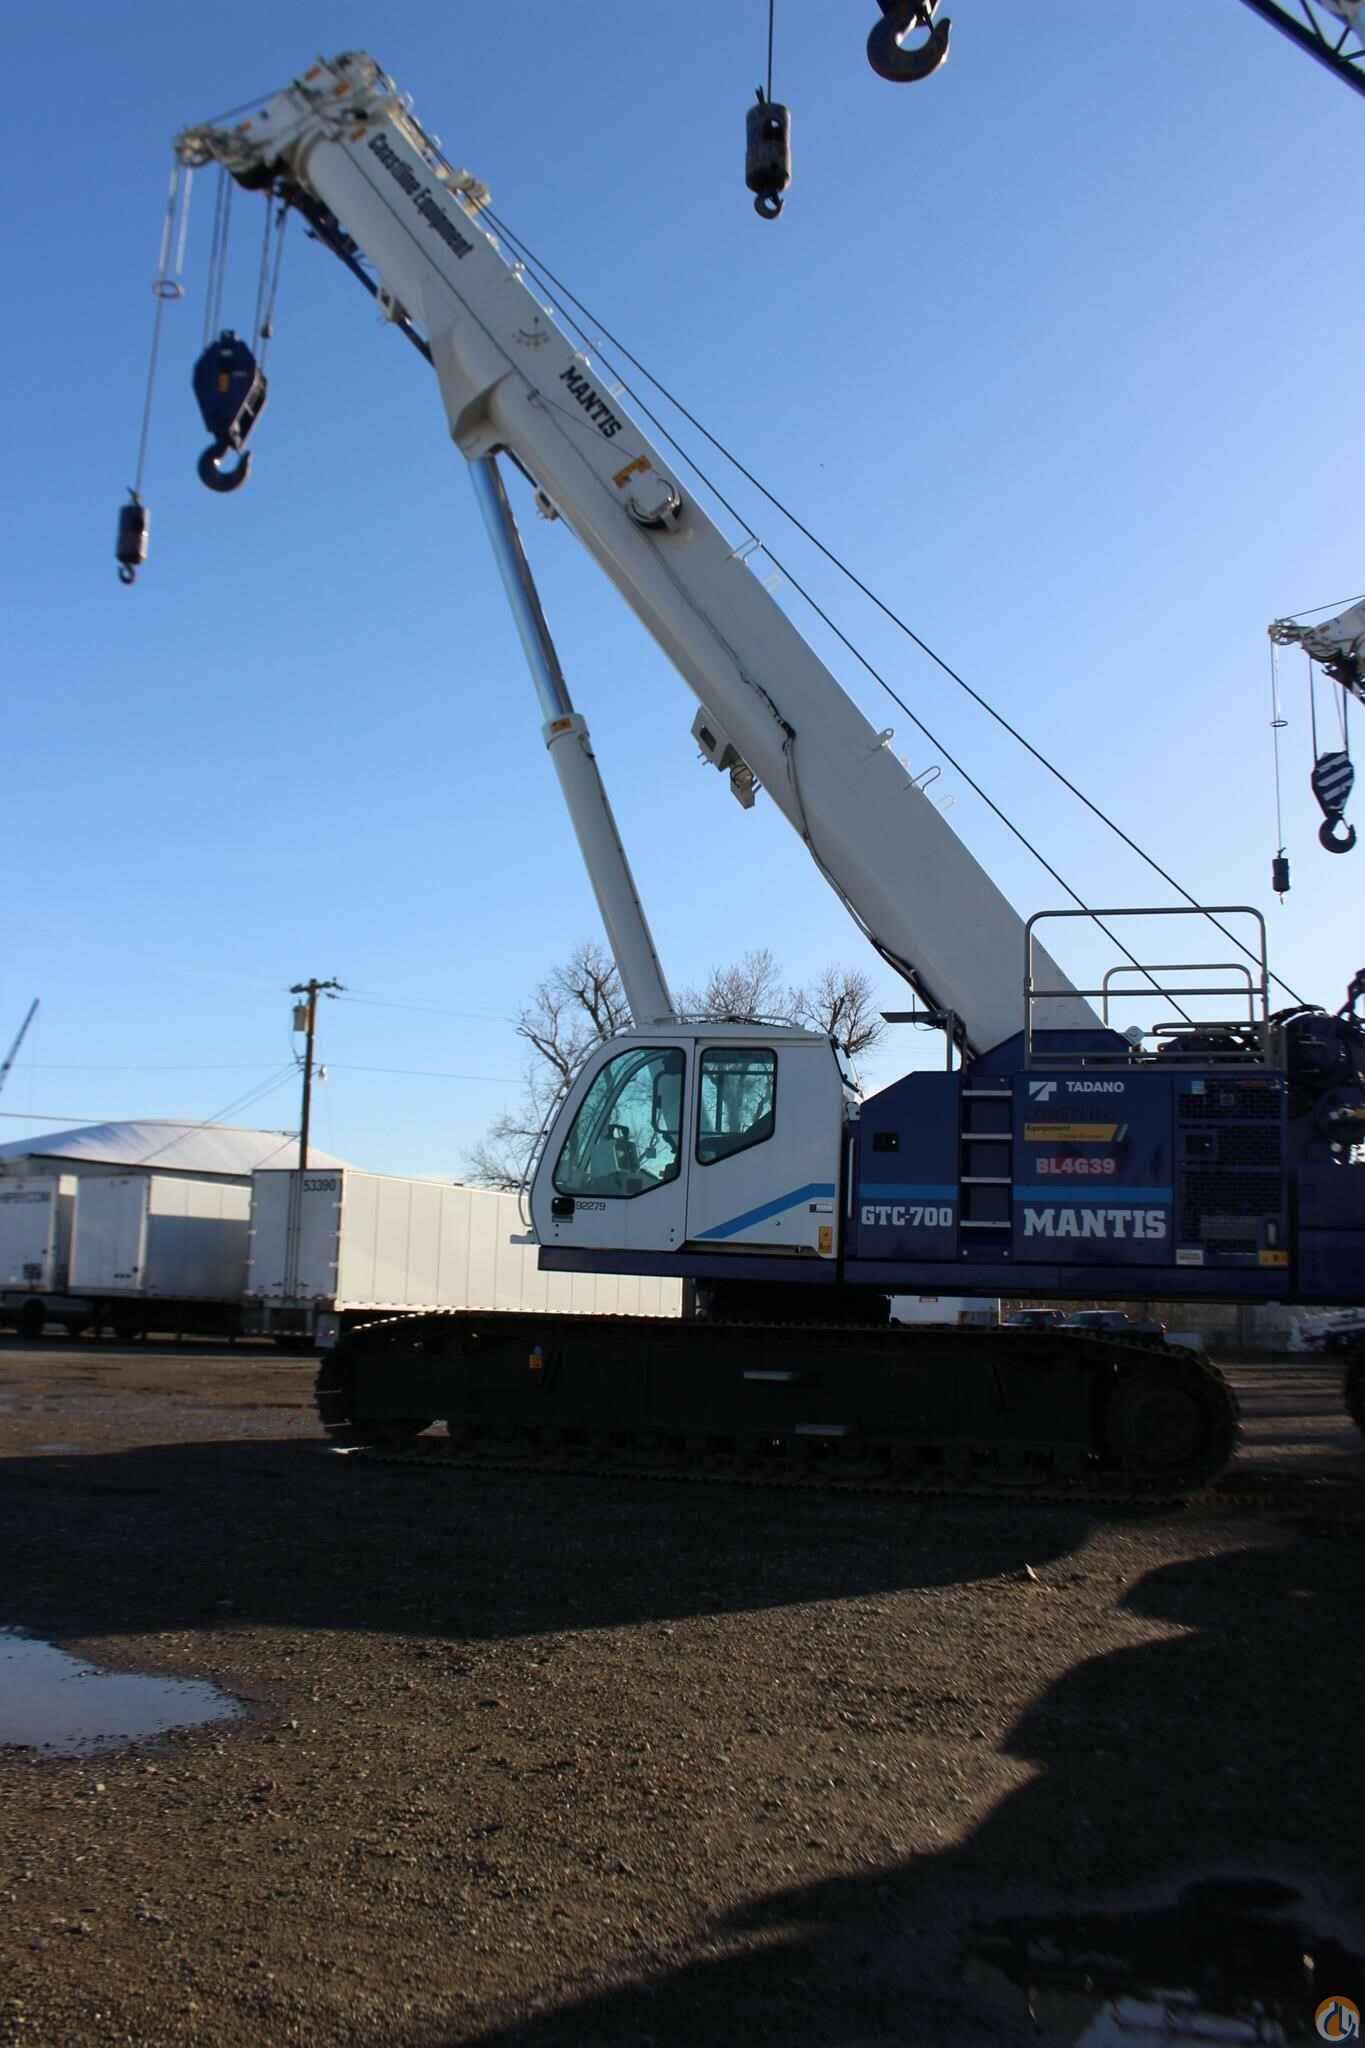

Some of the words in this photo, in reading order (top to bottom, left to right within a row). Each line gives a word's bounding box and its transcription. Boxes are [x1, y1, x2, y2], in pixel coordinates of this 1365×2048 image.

[560, 364, 622, 438] MANTIS
[1065, 1081, 1125, 1093] TADANO
[861, 1205, 953, 1227] GTC-700
[1023, 1208, 1167, 1239] MANTIS
